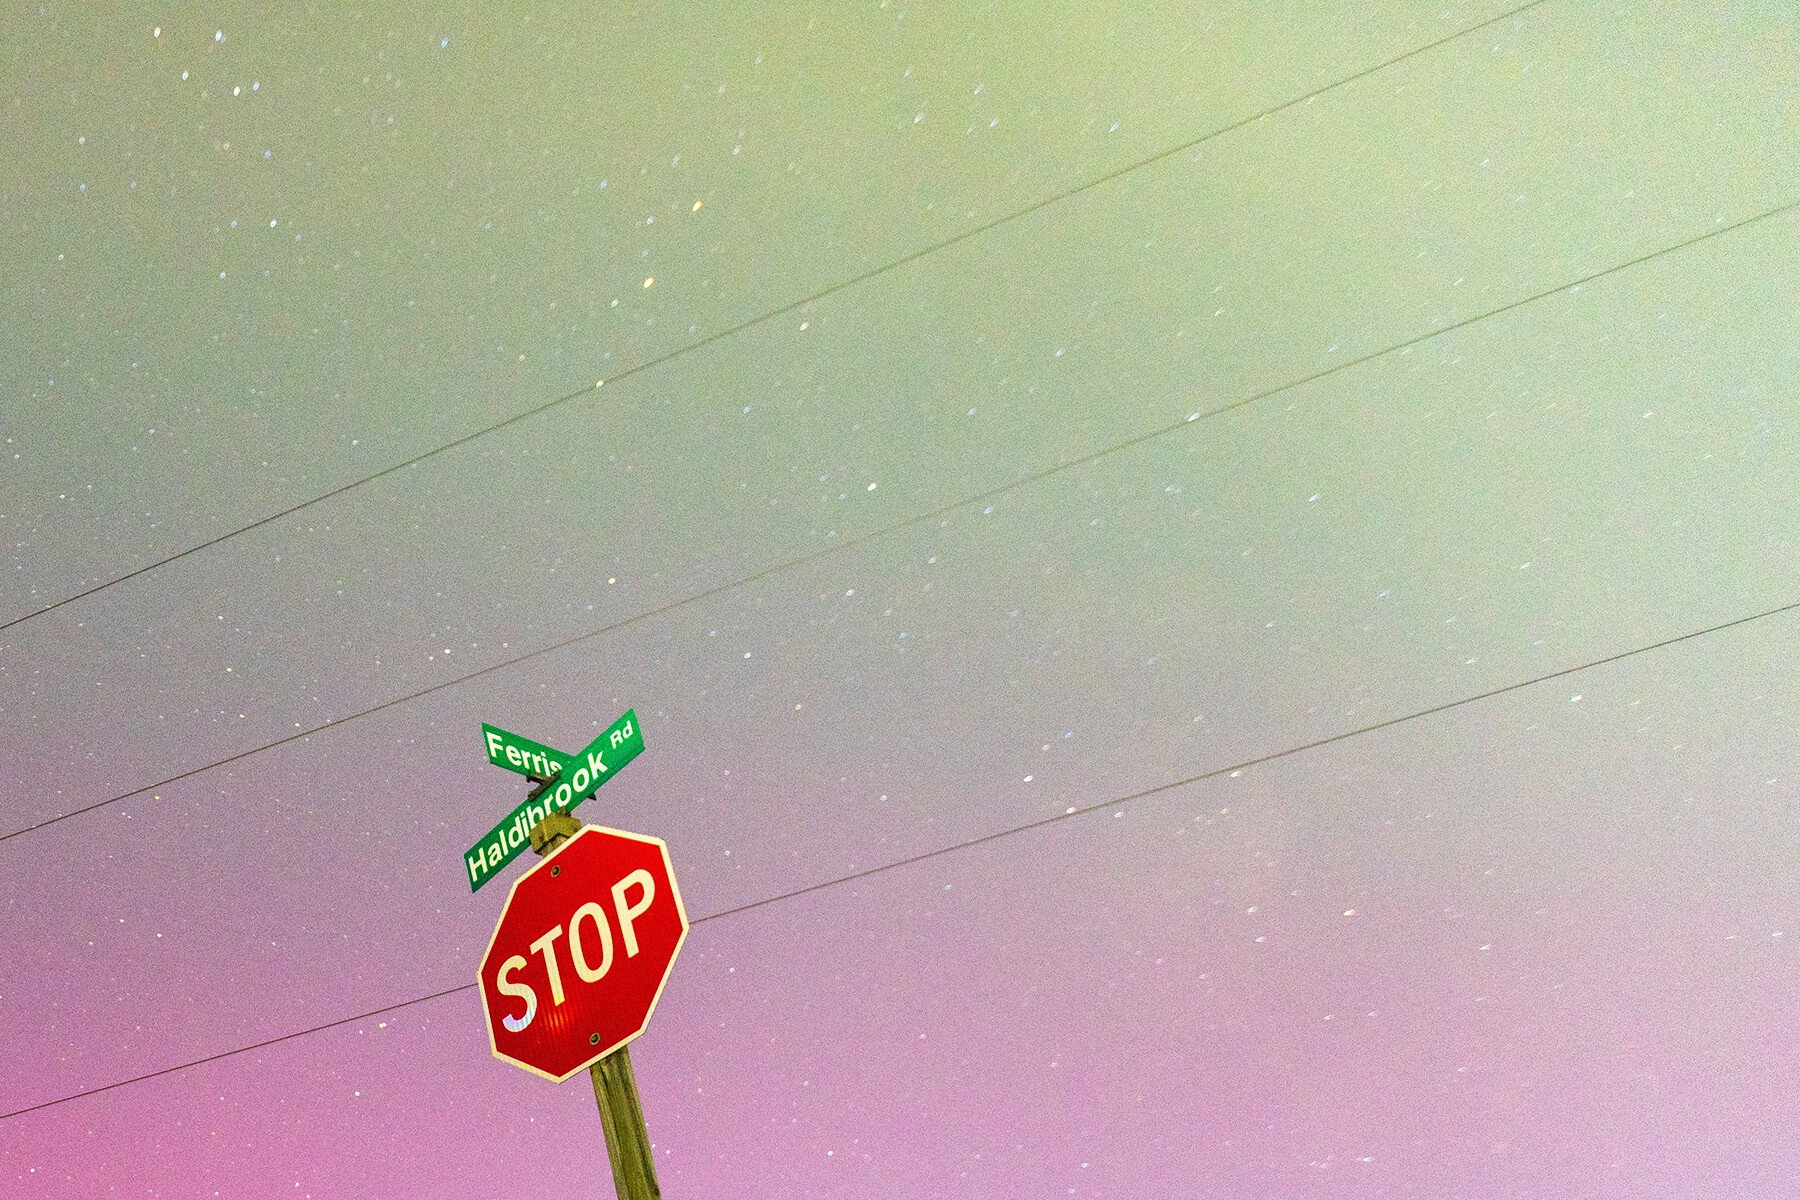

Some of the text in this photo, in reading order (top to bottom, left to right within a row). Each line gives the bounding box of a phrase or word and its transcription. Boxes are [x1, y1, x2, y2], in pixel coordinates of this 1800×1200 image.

[467, 720, 633, 882] Haldibrook Rd
[496, 869, 655, 1032] STOP
